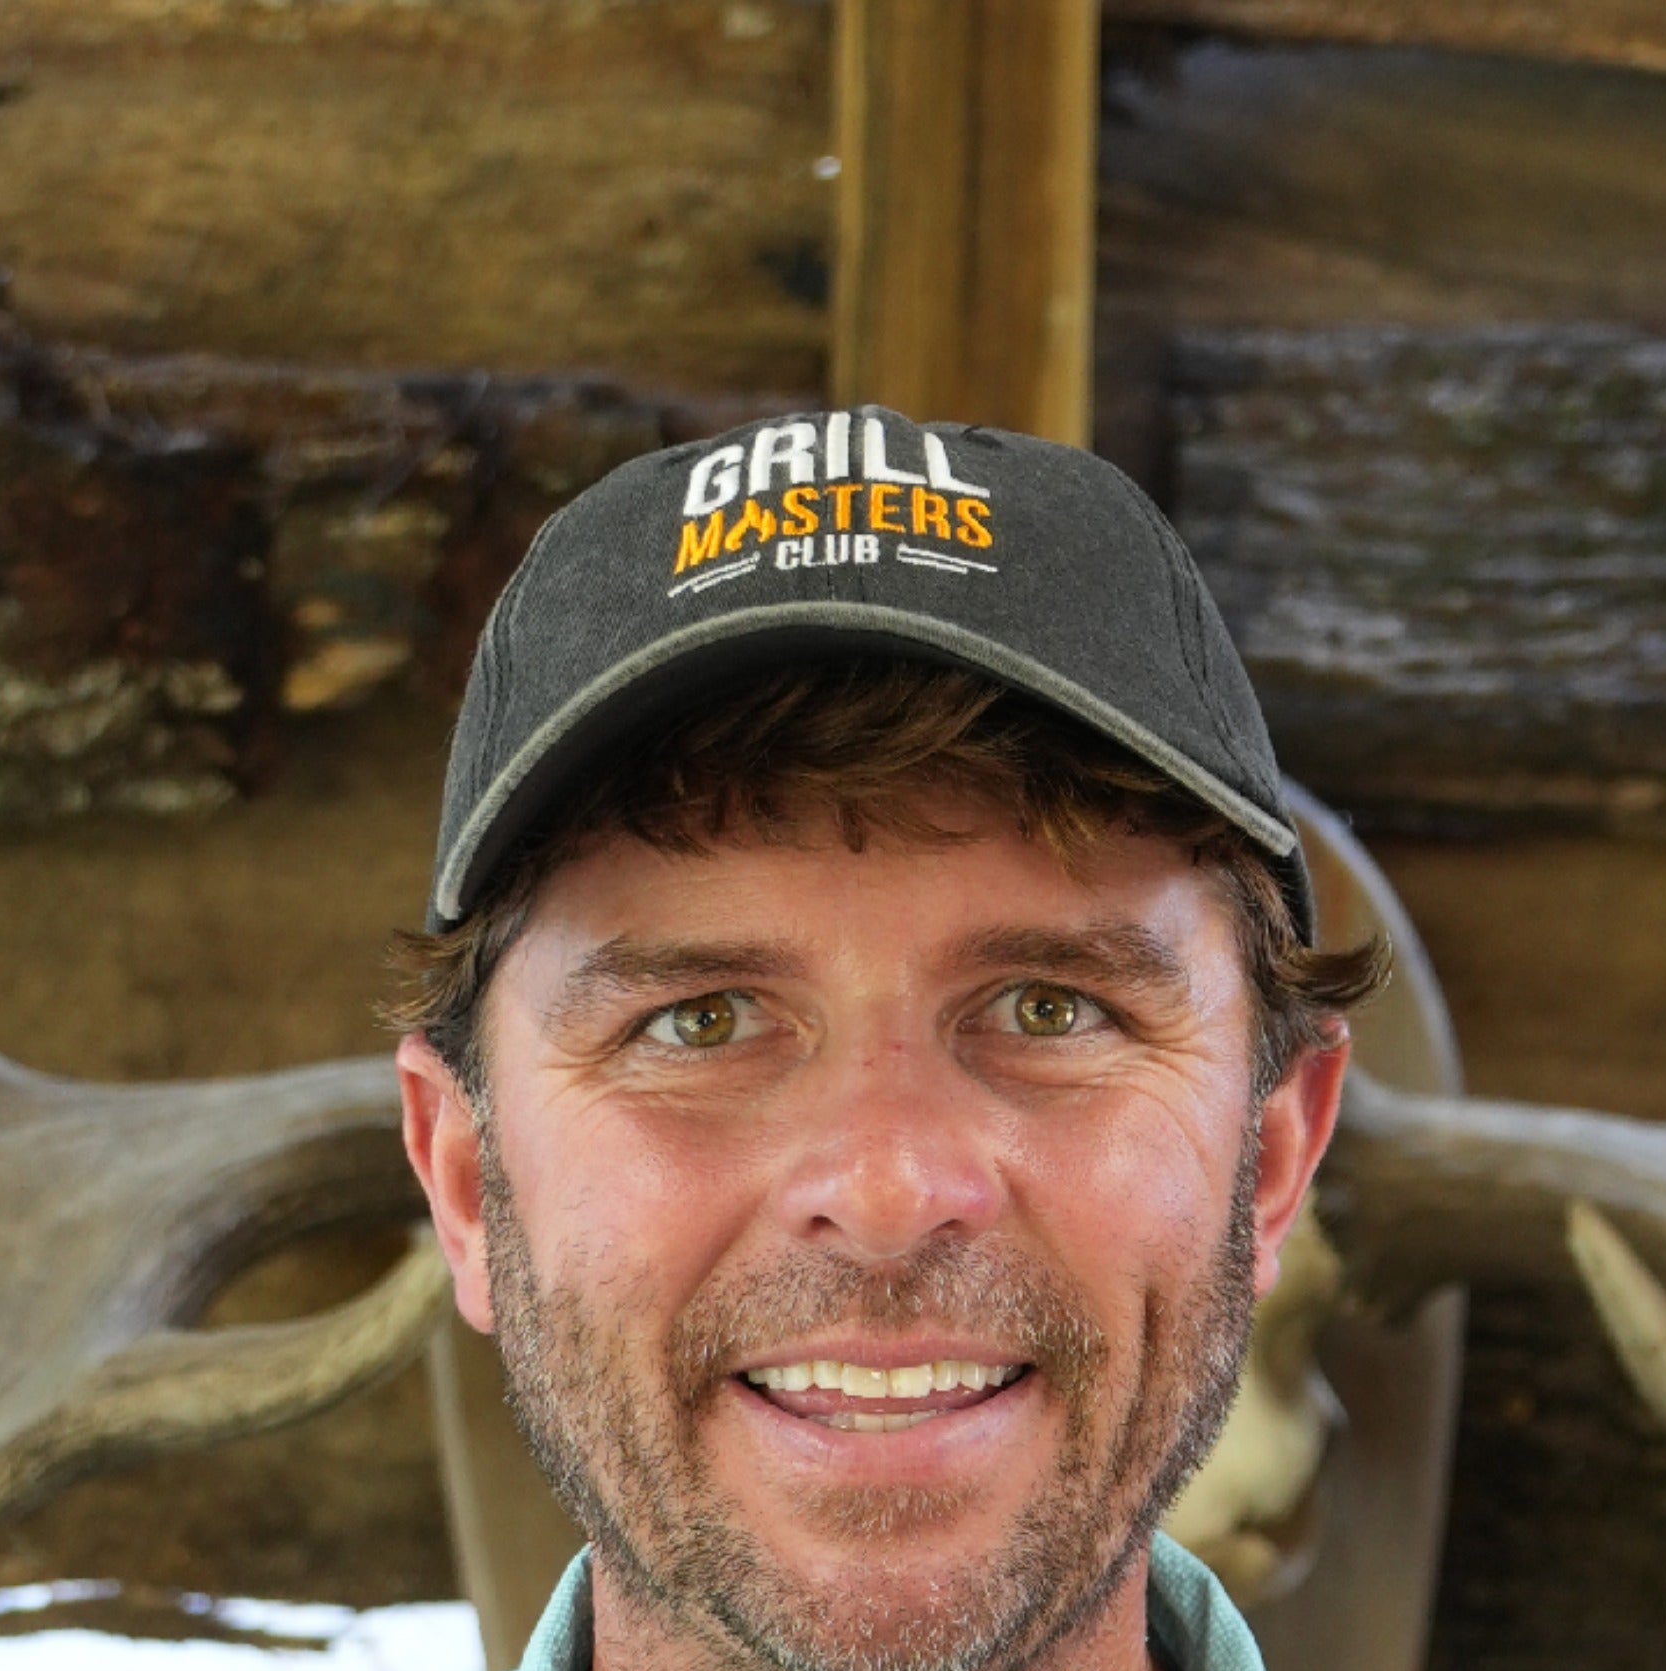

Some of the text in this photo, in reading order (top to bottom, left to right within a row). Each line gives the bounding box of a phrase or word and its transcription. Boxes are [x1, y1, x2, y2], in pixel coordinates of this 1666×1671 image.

[684, 411, 990, 517] GRILL
[673, 483, 994, 576] MASTERS
[774, 533, 880, 570] CLUB
